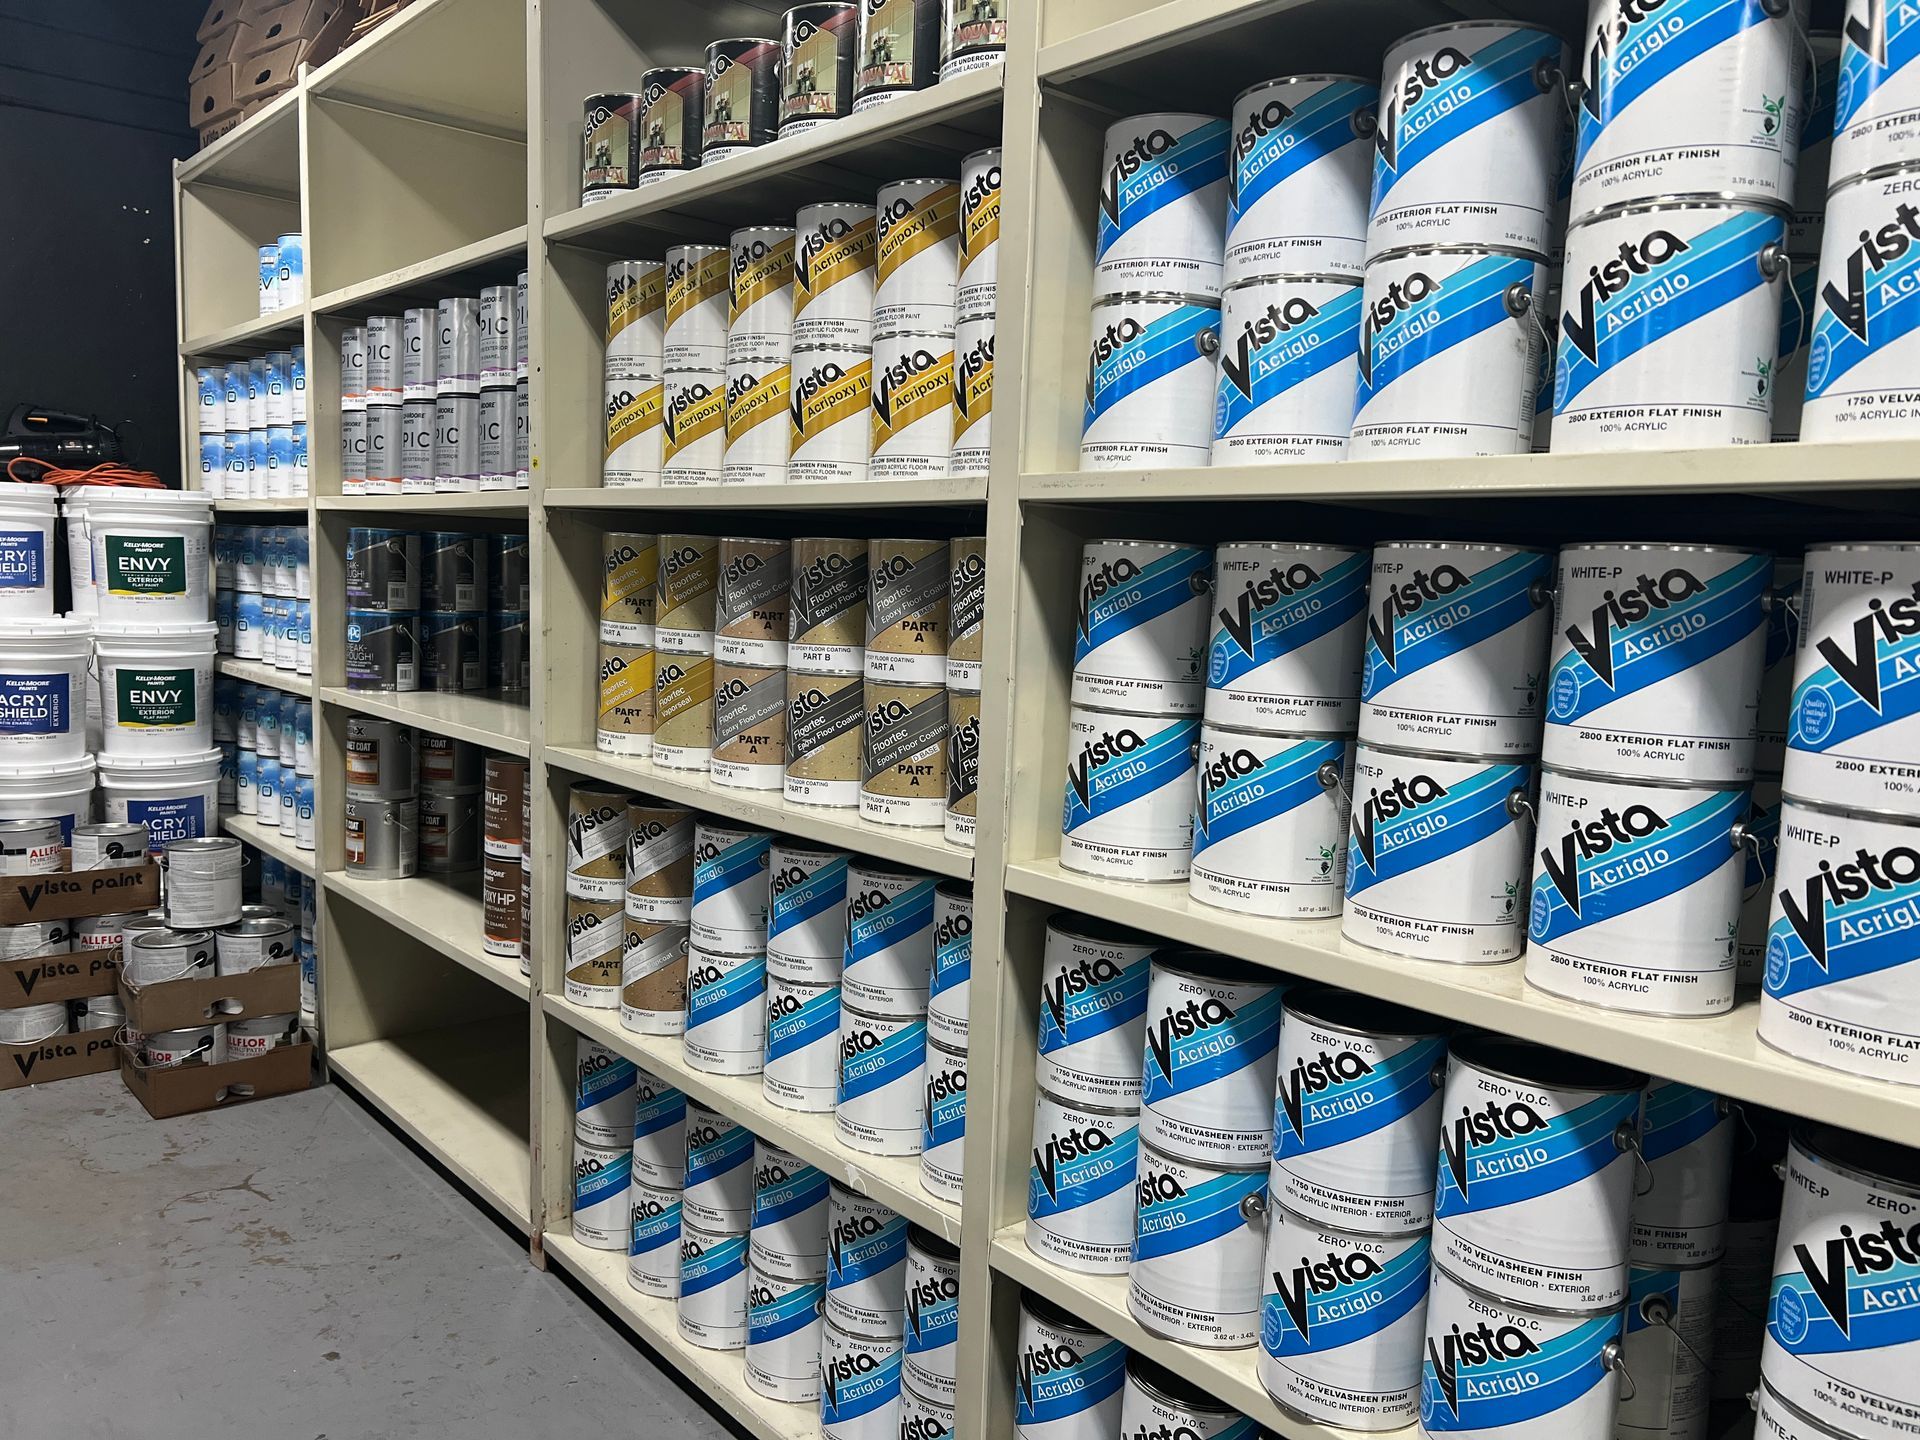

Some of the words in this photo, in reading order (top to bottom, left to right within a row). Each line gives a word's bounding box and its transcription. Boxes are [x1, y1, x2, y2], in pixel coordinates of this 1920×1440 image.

[959, 54, 999, 66] UNDERCOAT
[860, 95, 892, 103] UNDERCOAT
[787, 122, 817, 131] UNDERCOAT
[880, 222, 927, 259] Acripoxy
[928, 211, 937, 222] II
[796, 218, 853, 295] Vista
[814, 237, 864, 274] Acripoxy
[1114, 262, 1148, 270] EXTERIOR
[1173, 262, 1199, 270] FINISH
[1120, 271, 1134, 279] 100%
[1136, 270, 1164, 278] ACRYLIC
[611, 291, 647, 321] Acripoxy
[1562, 229, 1690, 368] Vista
[1605, 273, 1690, 332] Acriglo
[1221, 297, 1319, 403] Vista
[1258, 333, 1319, 376] Acriglo
[791, 363, 846, 437] Vista
[807, 384, 858, 418] Acripoxy
[859, 377, 868, 387] II
[872, 349, 939, 431] Vista
[729, 392, 769, 425] Acripoxy
[770, 385, 779, 396] II
[610, 407, 646, 435] Acripoxy
[1569, 414, 1588, 423] 2800
[1589, 410, 1643, 420] EXTERIOR
[1649, 408, 1677, 417] FLAT
[1682, 408, 1722, 418] FINISH
[1599, 424, 1622, 433] 100%
[1624, 422, 1668, 432] ACRYLIC
[403, 433, 430, 447] PIC
[1229, 438, 1244, 447] 2800
[1246, 438, 1288, 446] EXTERIOR
[1290, 437, 1311, 446] FLAT
[1313, 438, 1343, 447] FINISH
[1274, 448, 1306, 456] ACRYLIC
[119, 557, 172, 570] ENVY
[1222, 561, 1260, 571] WHITE-P
[1571, 567, 1623, 579] WHITE-P
[669, 570, 702, 592] Floortec
[1825, 570, 1894, 585] WHITE-P
[674, 579, 709, 601] Vaporseal
[729, 579, 763, 601] Floortec
[810, 580, 848, 605] Floortec
[625, 598, 653, 607] PART
[753, 611, 784, 621] PART
[1218, 564, 1322, 662] Vista
[1260, 596, 1322, 638] Acriglo
[764, 621, 772, 630] A
[902, 621, 938, 631] PART
[1564, 568, 1707, 692] Vista
[914, 632, 924, 642] A
[1622, 612, 1707, 660] Acriglo
[0, 695, 48, 707] ACRY
[130, 690, 183, 703] ENVY
[659, 687, 685, 706] Floortec
[661, 696, 692, 717] Vaporseal
[1228, 694, 1245, 702] 2800
[1247, 696, 1290, 705] EXTERIOR
[1293, 698, 1314, 706] FLAT
[1316, 700, 1342, 708] FINISH
[719, 704, 748, 725] Floortec
[1275, 708, 1307, 717] ACRYLIC
[722, 720, 744, 737] Epoxy
[744, 711, 764, 725] Floor
[356, 743, 371, 751] COAT
[431, 740, 447, 748] COAT
[873, 728, 908, 754] Floortec
[877, 749, 898, 766] Epoxy
[899, 740, 919, 755] Floor
[898, 765, 933, 775] PART
[910, 775, 920, 786] A
[493, 794, 508, 805] HP
[426, 816, 440, 825] COAT
[148, 829, 186, 842] HIELD
[696, 865, 724, 885] Acriglo
[18, 880, 81, 912] Vista
[92, 873, 143, 895] paint
[498, 894, 516, 905] HP
[856, 915, 895, 939] Acriglo
[81, 934, 122, 945] ALLFLO
[15, 963, 79, 996] Vista
[695, 988, 727, 1008] Acriglo
[861, 987, 886, 996] ENAMEL
[1344, 1041, 1376, 1054] V.O.C.
[14, 1043, 77, 1078] Vista
[1278, 1050, 1375, 1147] Vista
[1309, 1091, 1374, 1121] Acriglo
[580, 1177, 608, 1193] Acriglo
[1790, 1165, 1830, 1198] WHITE-P
[1285, 1185, 1299, 1198] 100%
[1299, 1193, 1329, 1210] ACRYLIC
[1331, 1203, 1368, 1216] INTERIOR
[1375, 1210, 1412, 1218] EXTERIOR
[1292, 1178, 1309, 1190] 1750
[1311, 1187, 1370, 1206] VELVASHEEN
[1374, 1200, 1405, 1208] FINISH
[828, 1215, 884, 1280] Vista
[848, 1240, 888, 1264] Acriglo
[822, 1352, 880, 1418] Vista
